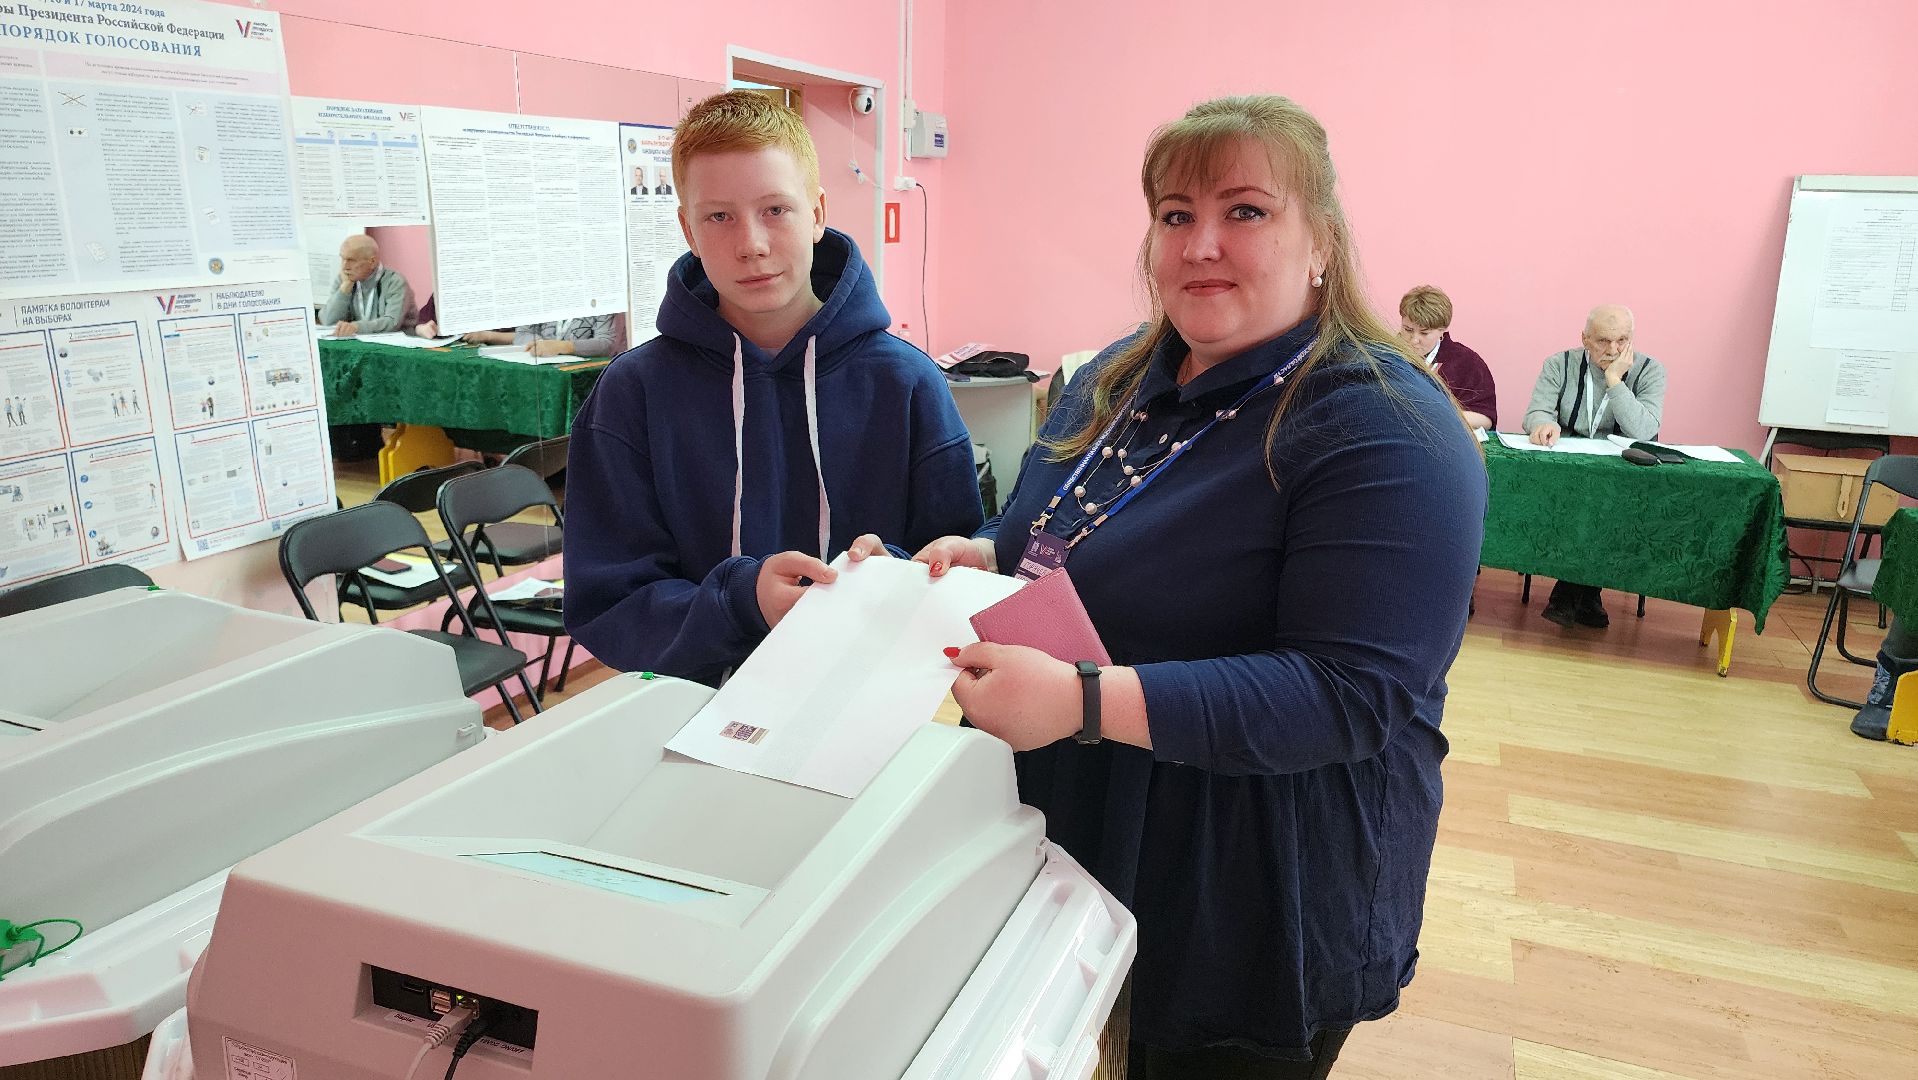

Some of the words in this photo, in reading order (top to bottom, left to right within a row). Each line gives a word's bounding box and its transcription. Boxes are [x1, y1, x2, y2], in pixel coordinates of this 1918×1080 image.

[88, 0, 118, 12] марта
[120, 3, 143, 14] 2024
[144, 8, 165, 18] года
[18, 4, 94, 24] Президента
[96, 14, 164, 33] Российской
[166, 23, 225, 40] Федерации
[85, 33, 202, 57] ГОЛОСОВАНИЯ
[21, 303, 59, 316] ПАМЯТКА
[60, 299, 111, 312] ВОЛОНТЕРАМ
[22, 316, 34, 326] НА
[35, 313, 73, 325] ВЫБОРАХ
